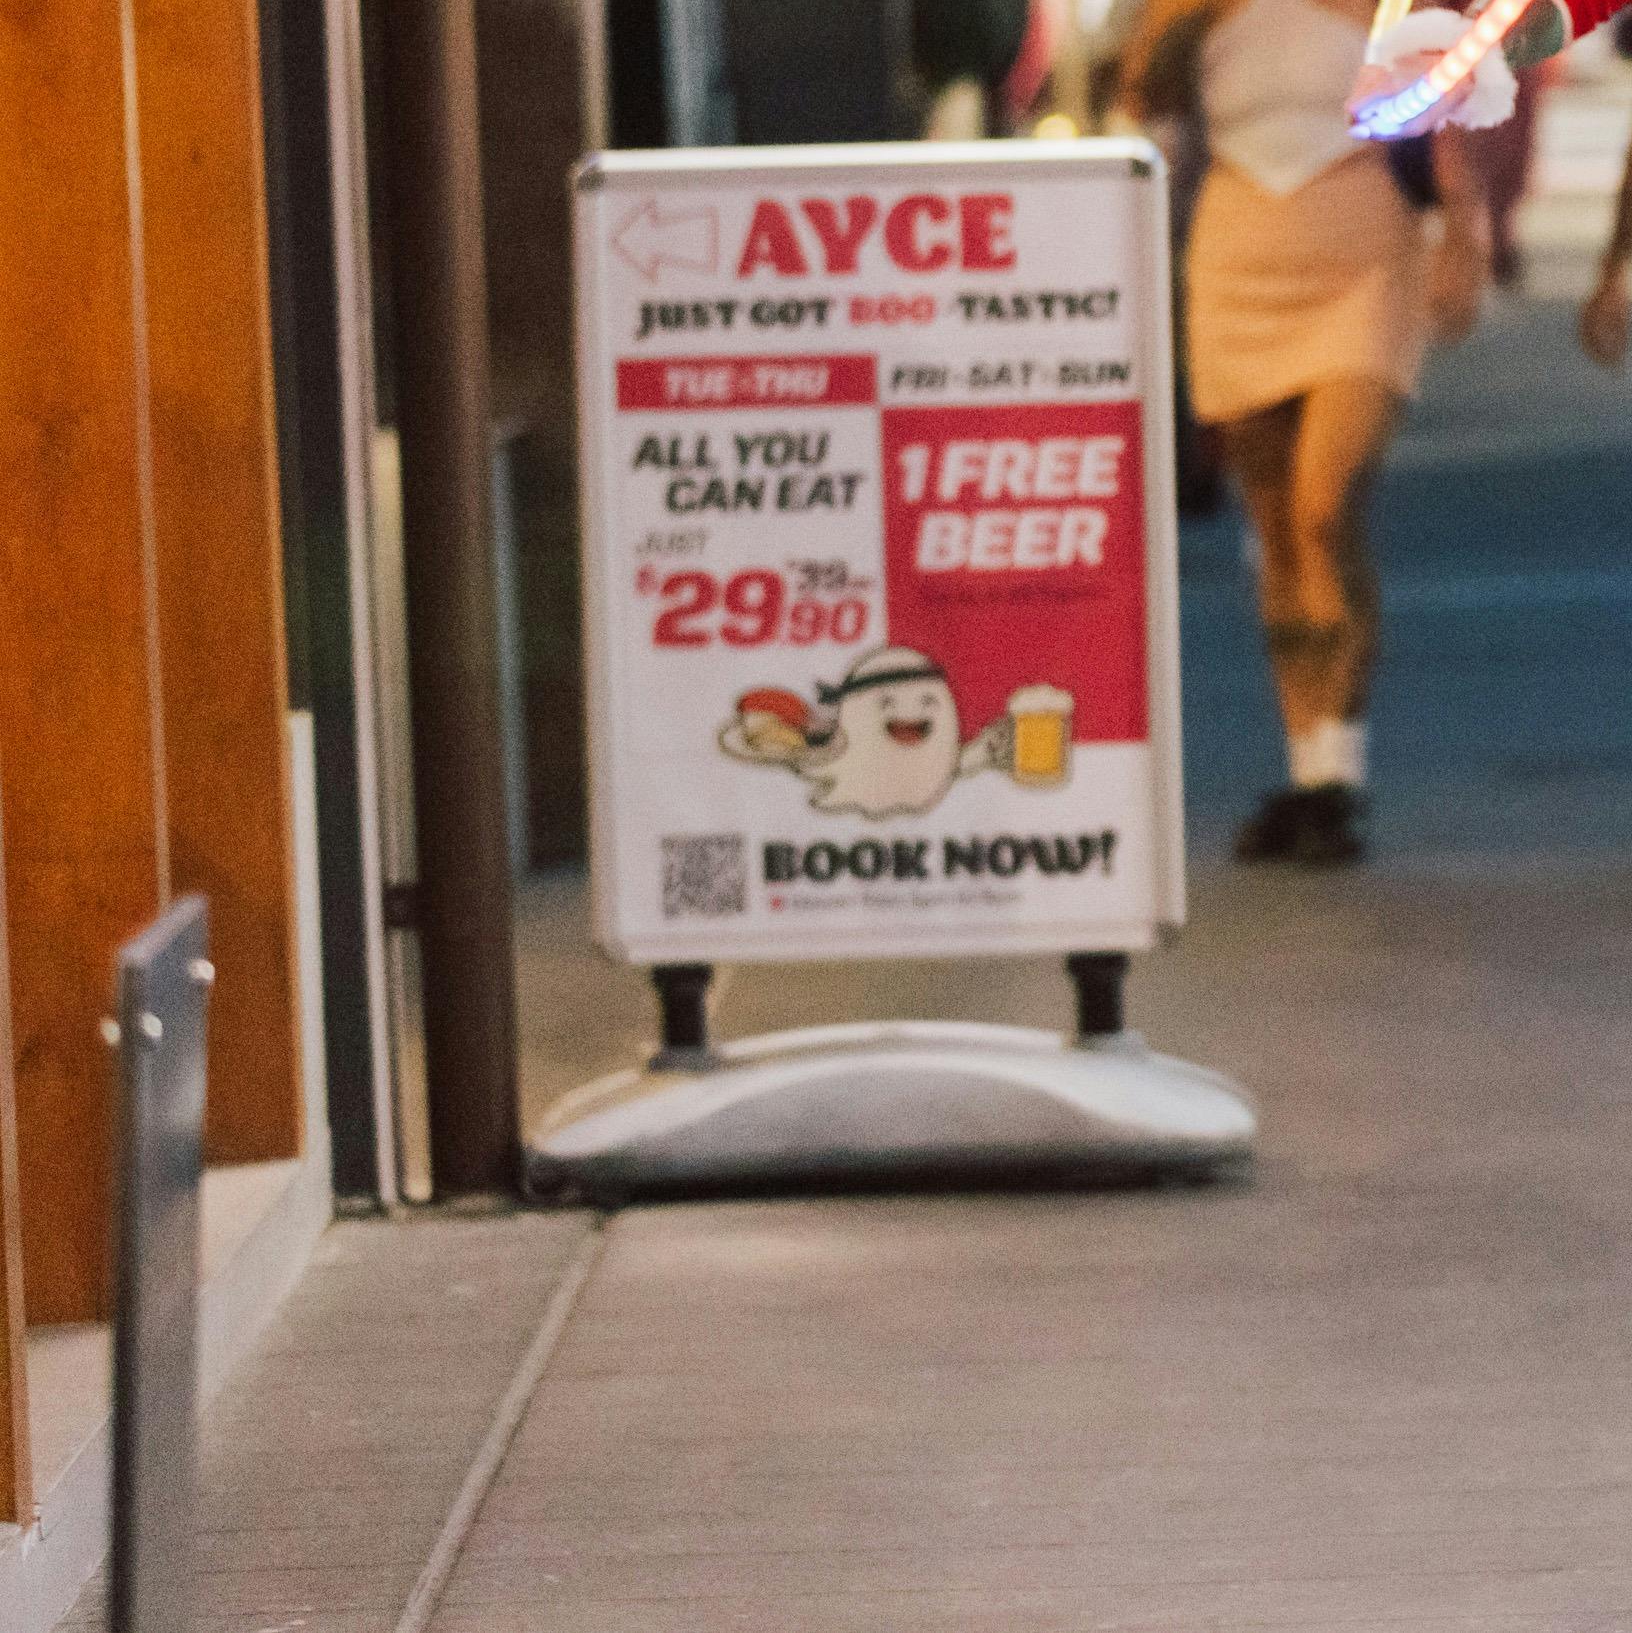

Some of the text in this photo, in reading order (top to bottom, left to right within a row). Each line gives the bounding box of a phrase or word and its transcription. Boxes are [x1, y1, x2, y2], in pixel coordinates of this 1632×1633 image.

[737, 192, 1017, 279] AYCE
[636, 300, 739, 340] JUST
[750, 297, 832, 329] GOT
[848, 294, 936, 325] BOO
[634, 429, 830, 470] ALL YOU
[899, 435, 1126, 503] 1 FREE
[664, 472, 863, 514] CAN EAT
[915, 508, 1108, 572] BEER
[762, 827, 1118, 884] BOOK NOW!
